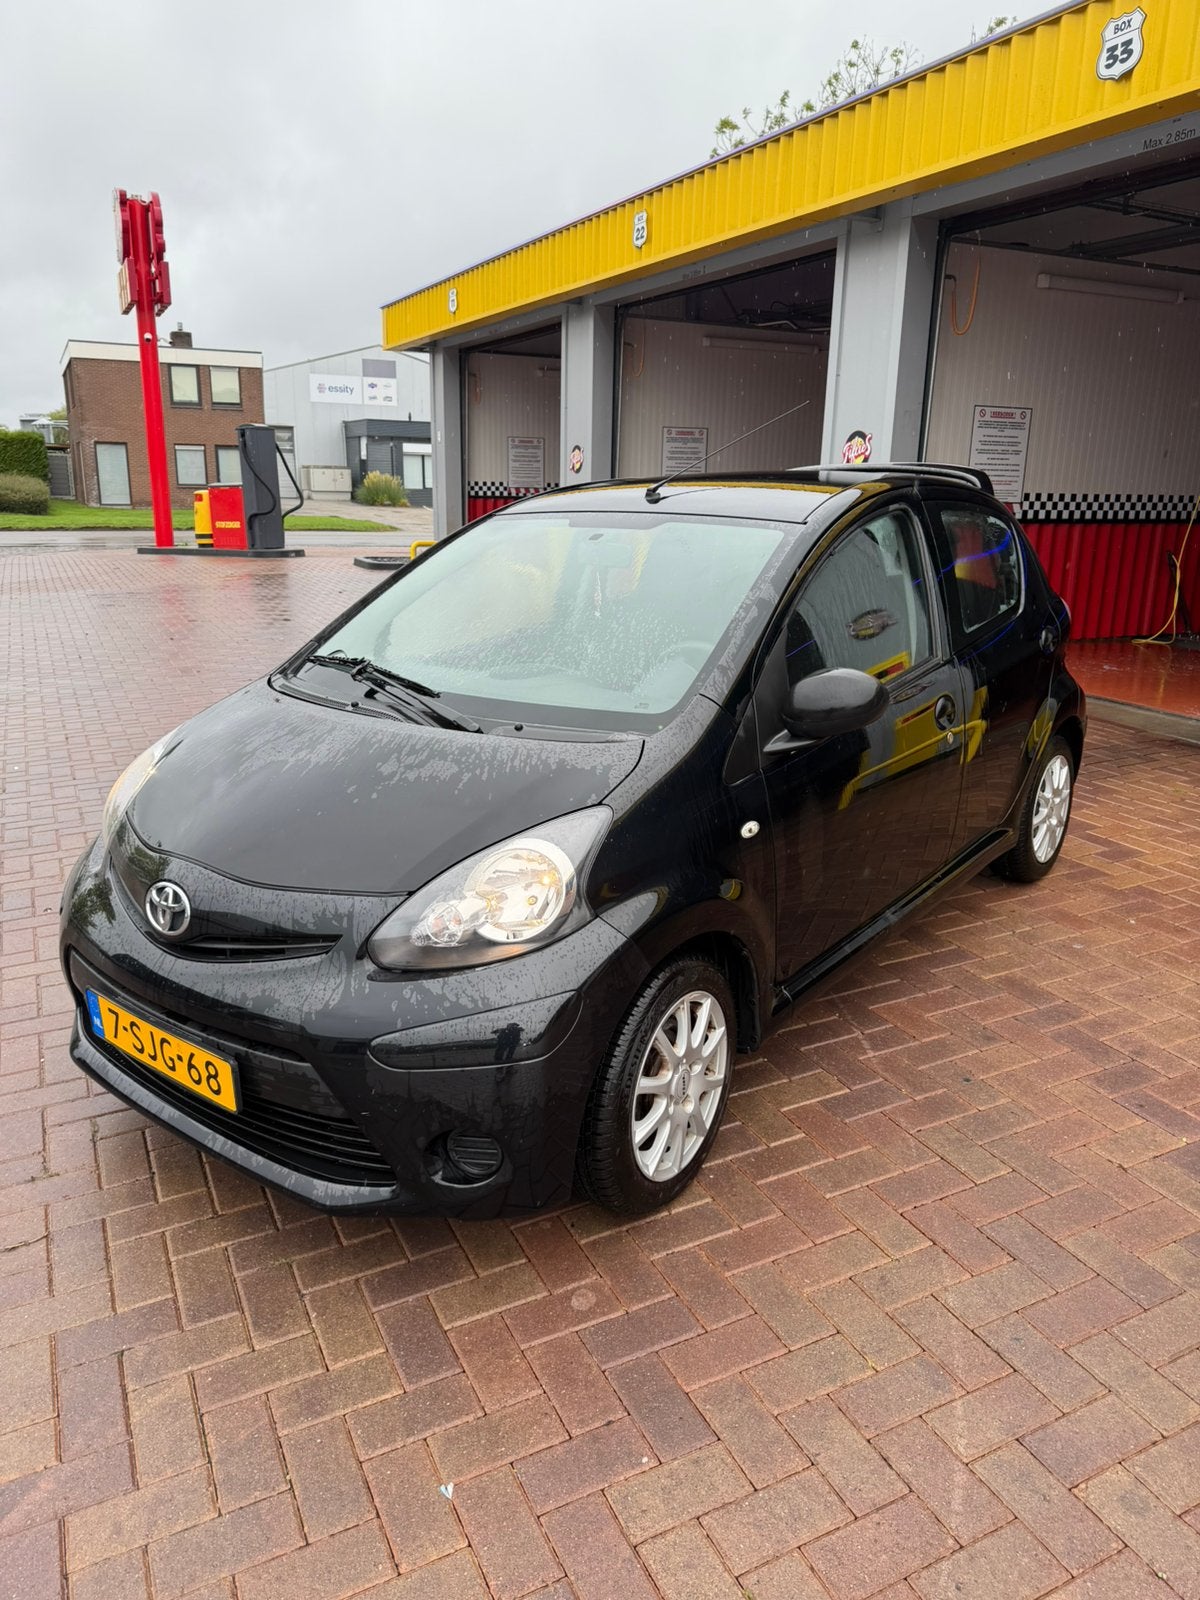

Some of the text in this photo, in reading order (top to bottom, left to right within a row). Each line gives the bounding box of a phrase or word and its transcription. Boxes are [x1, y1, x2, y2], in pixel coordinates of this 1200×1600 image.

[1113, 18, 1133, 35] BOX
[1104, 37, 1134, 70] 33
[1142, 127, 1196, 151] Max 2.85m
[635, 225, 646, 241] 22
[328, 384, 355, 395] essity
[107, 1007, 222, 1096] 7-SJG-68
